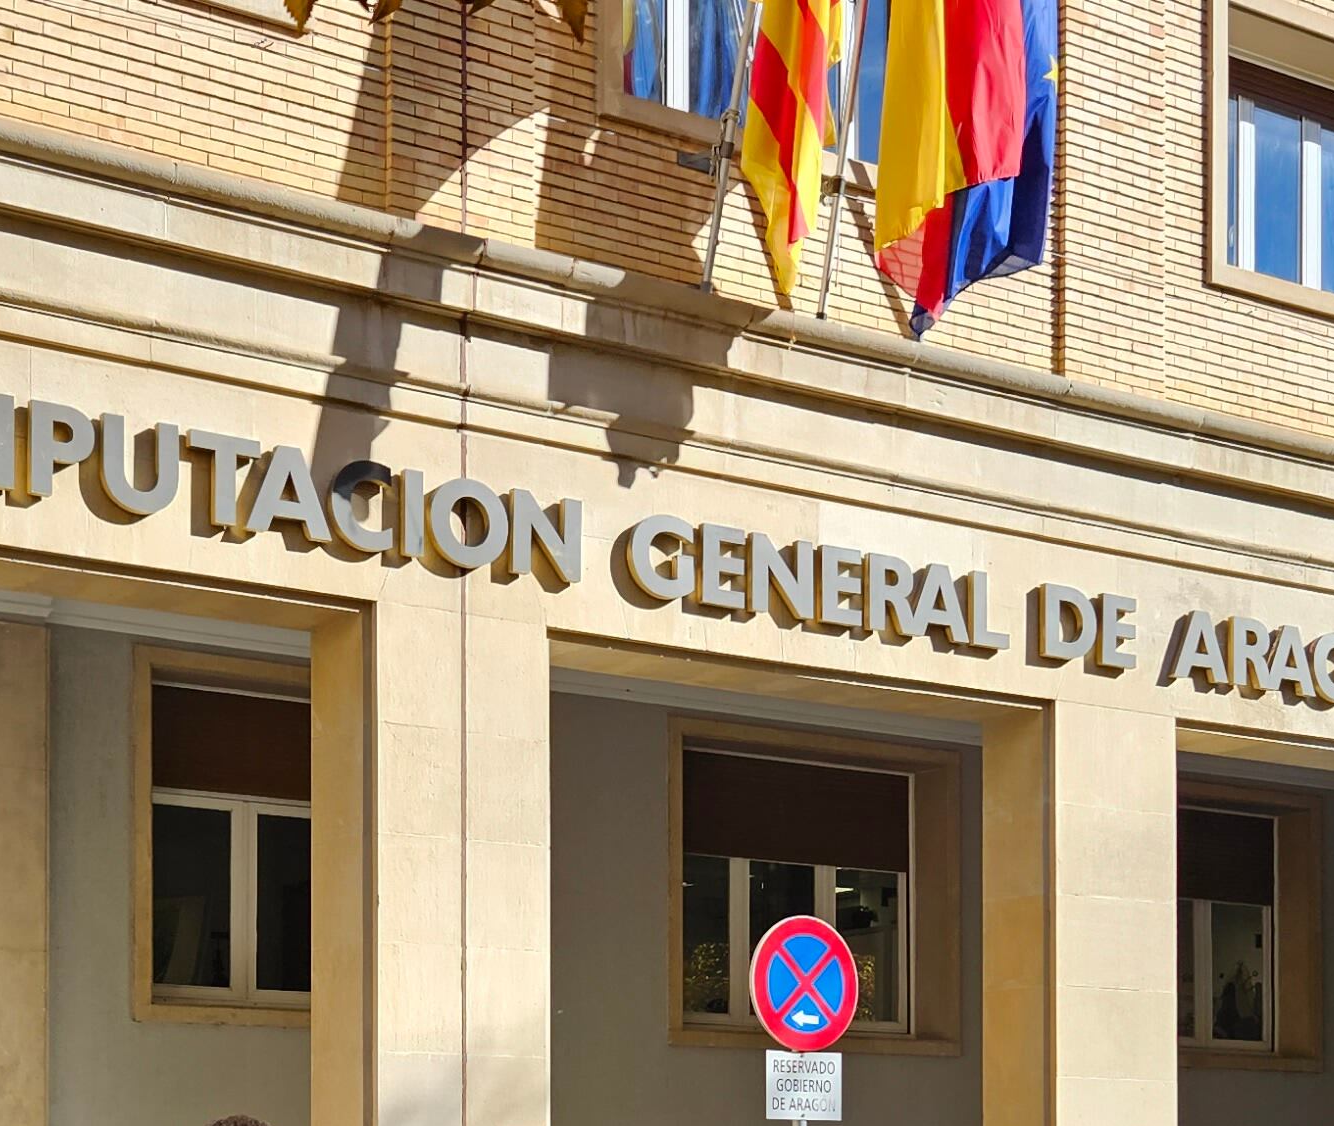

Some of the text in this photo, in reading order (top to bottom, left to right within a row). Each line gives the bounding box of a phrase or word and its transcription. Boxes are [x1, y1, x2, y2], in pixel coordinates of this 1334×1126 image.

[626, 513, 1011, 651] GENERAL
[1040, 582, 1138, 670] DE
[773, 1059, 835, 1075] RESERVADO
[776, 1078, 831, 1093] GOBIERNO
[772, 1096, 786, 1111] DE
